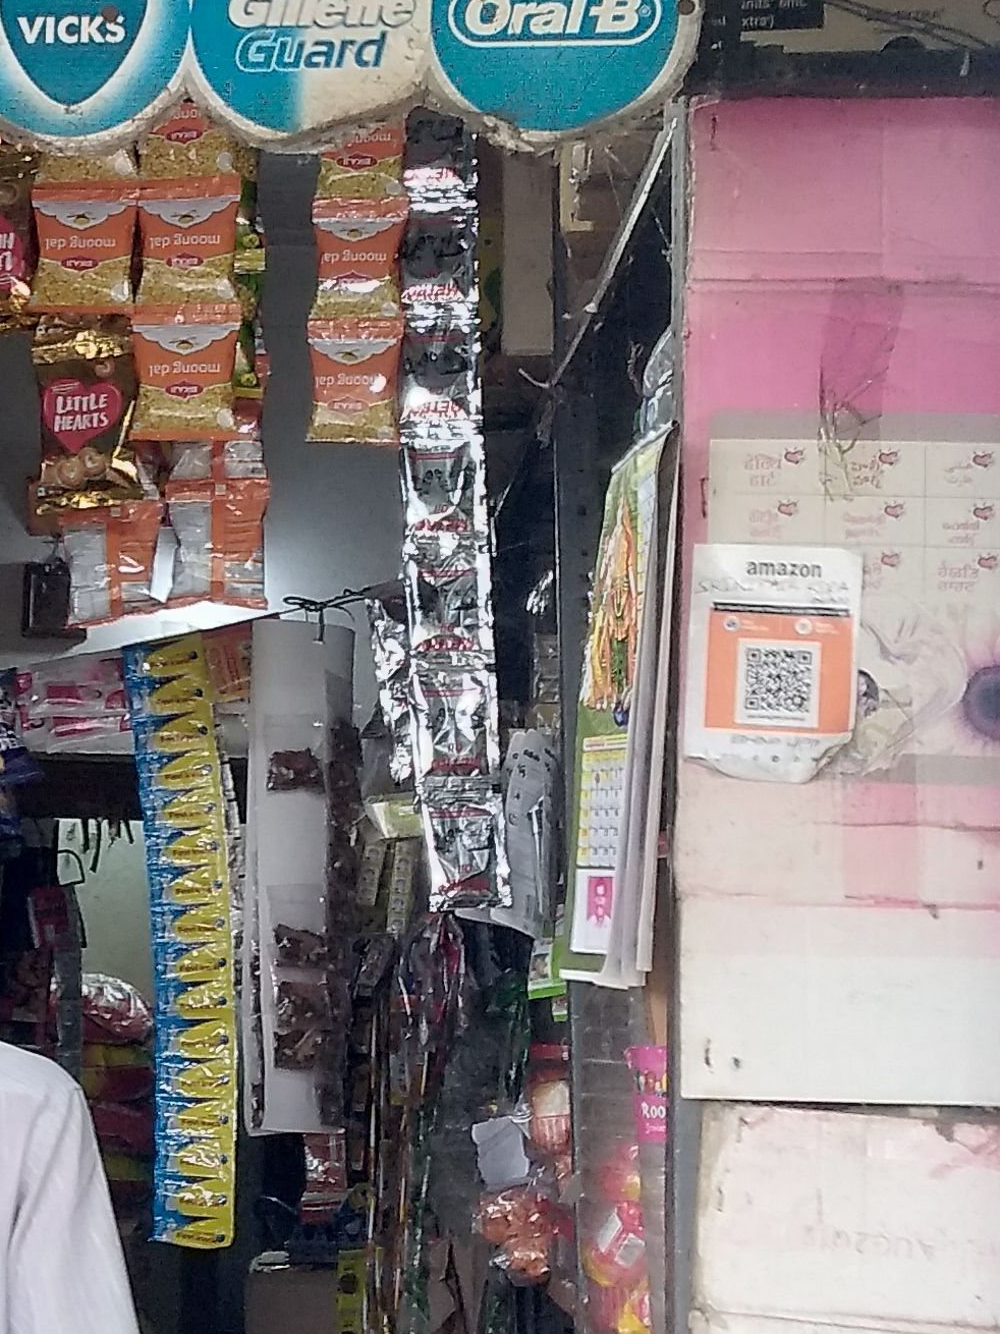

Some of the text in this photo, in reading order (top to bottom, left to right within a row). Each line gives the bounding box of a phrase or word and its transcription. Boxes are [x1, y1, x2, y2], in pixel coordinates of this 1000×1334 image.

[17, 15, 126, 46] VICKS
[236, 30, 386, 72] Guard
[45, 234, 117, 249] moong dal
[150, 233, 221, 249] moong dal
[343, 251, 388, 264] moong
[150, 360, 221, 375] moong dal
[315, 374, 335, 387] dal
[56, 393, 108, 414] LITTLE
[54, 411, 109, 432] HEARTS
[746, 559, 823, 579] amazon
